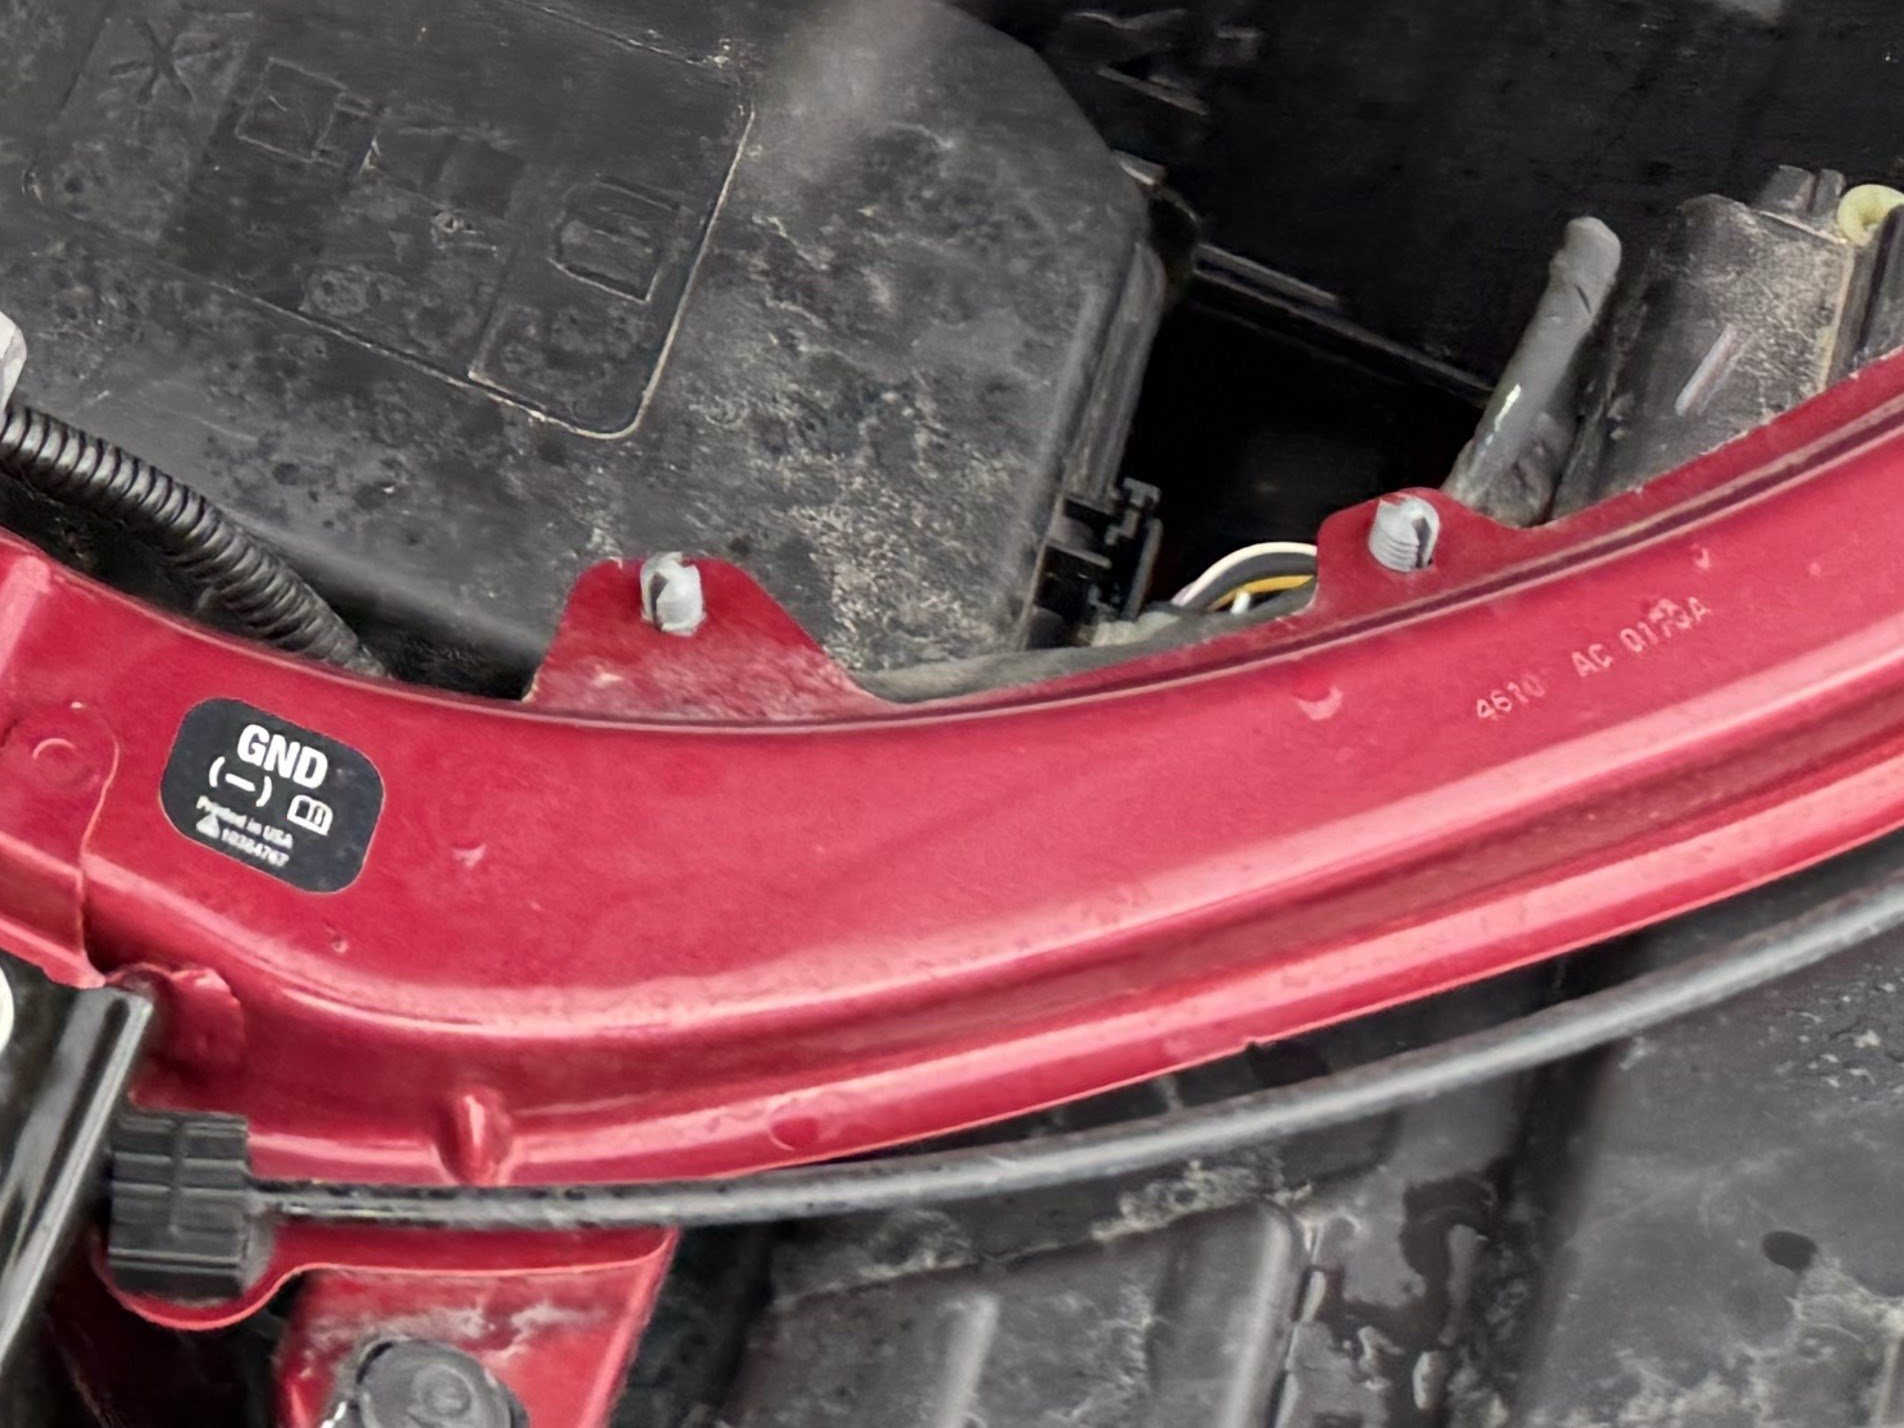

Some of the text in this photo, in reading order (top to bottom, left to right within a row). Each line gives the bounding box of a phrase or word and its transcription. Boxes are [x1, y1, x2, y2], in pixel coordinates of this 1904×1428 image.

[1571, 643, 1614, 678] AC
[236, 724, 328, 790] GND
[262, 820, 294, 850] USA
